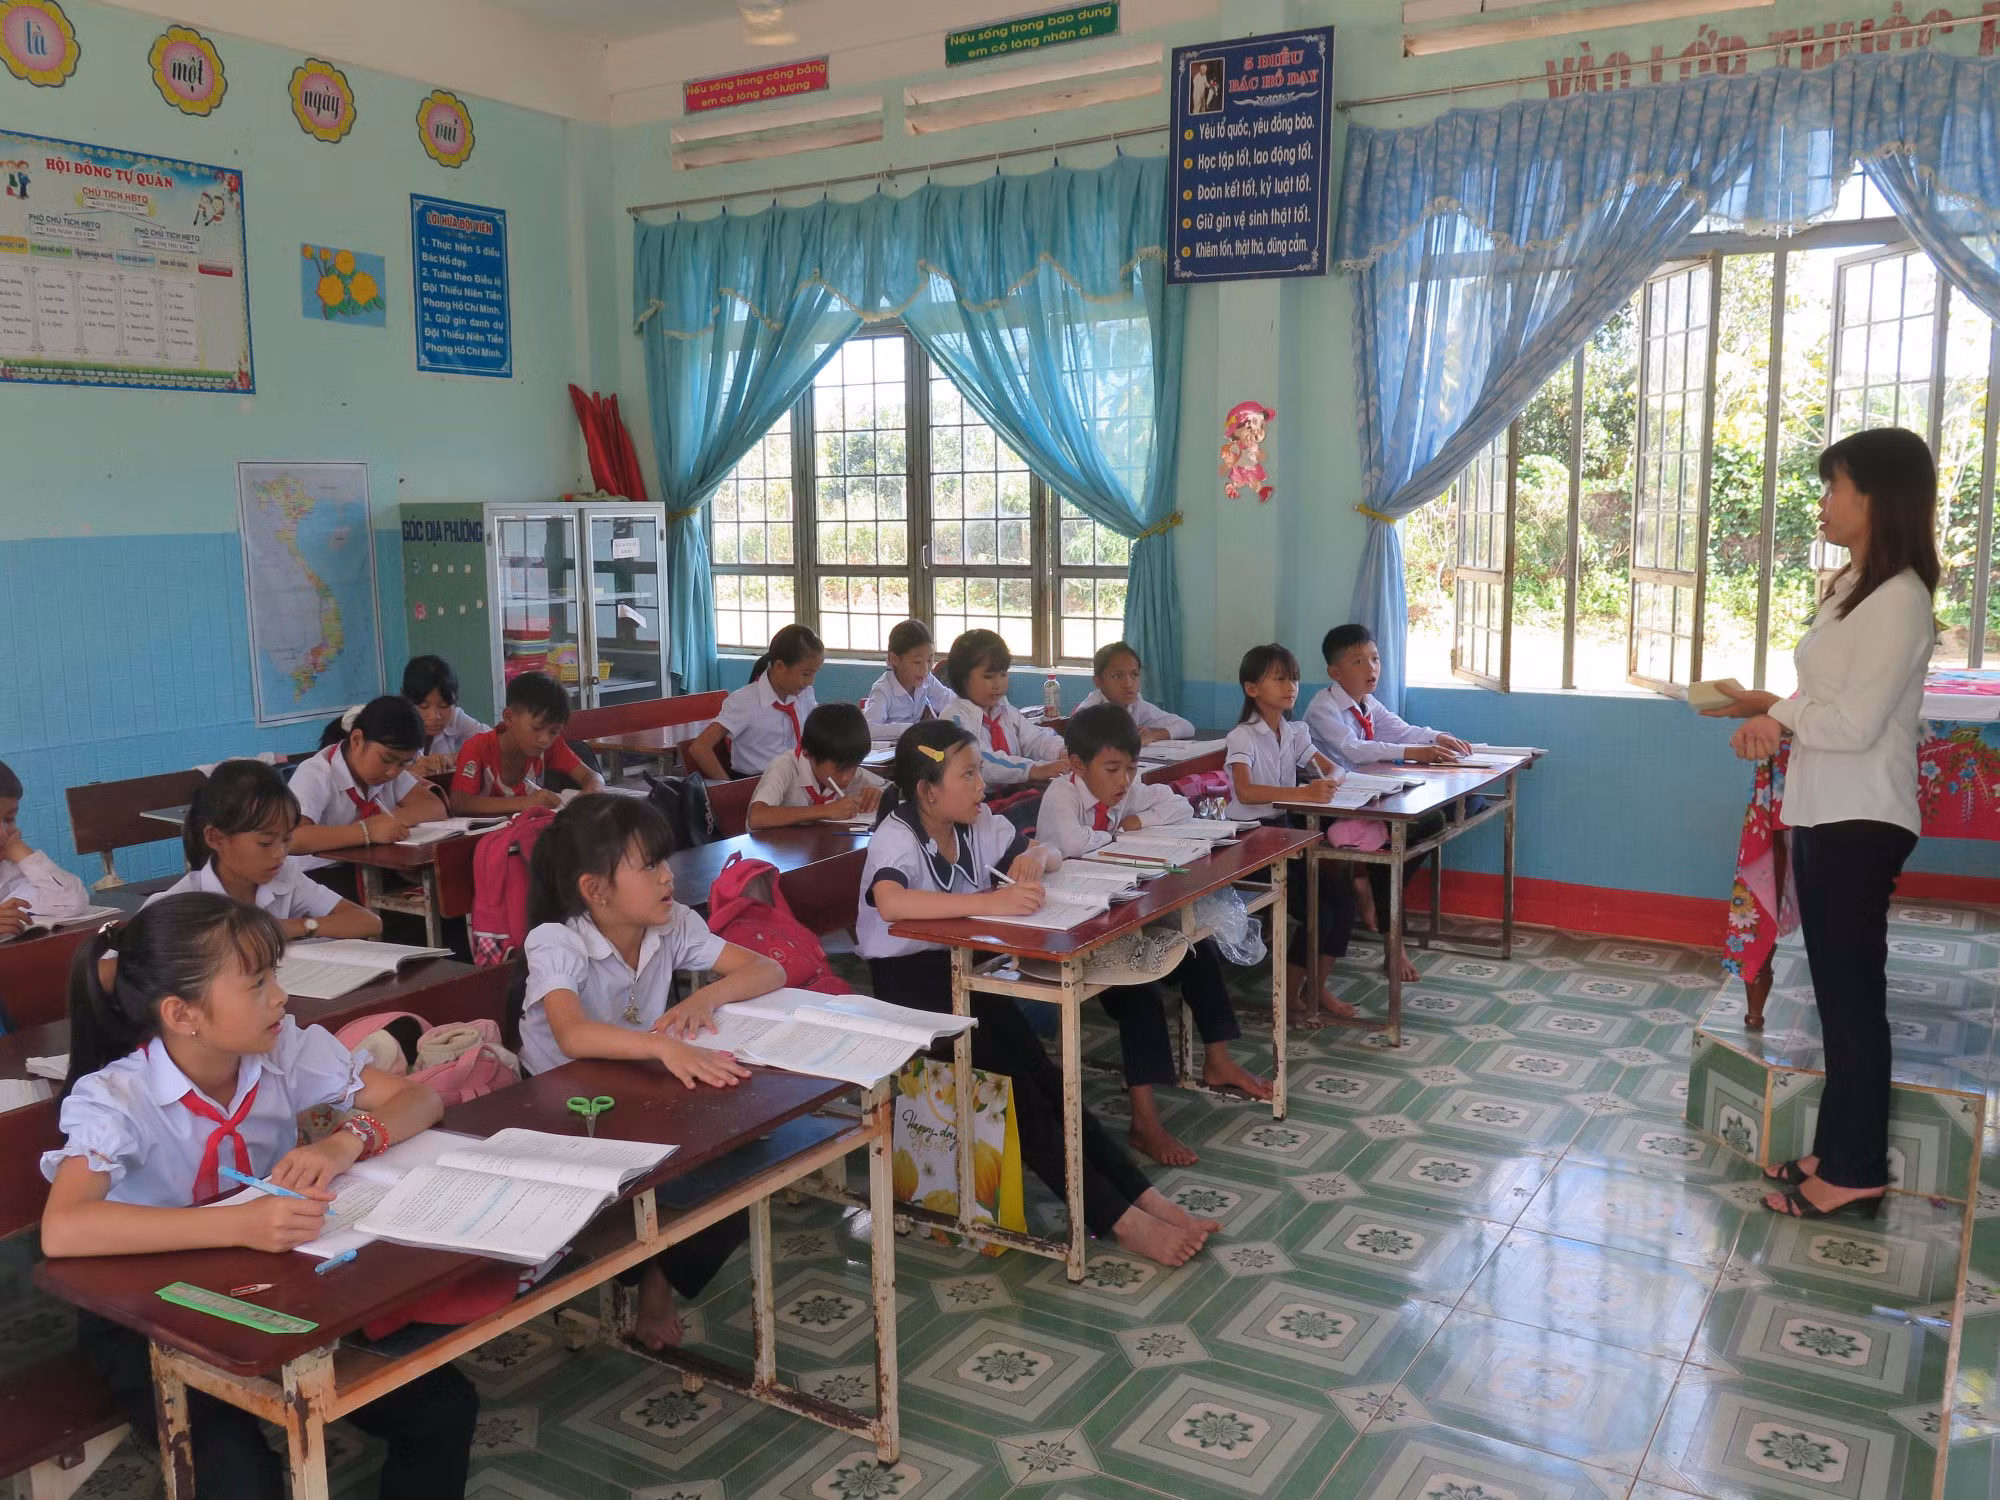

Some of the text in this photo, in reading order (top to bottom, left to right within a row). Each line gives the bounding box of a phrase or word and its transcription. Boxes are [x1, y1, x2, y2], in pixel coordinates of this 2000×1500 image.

[978, 27, 1008, 40] sống
[1012, 20, 1044, 33] trong
[1048, 14, 1074, 26] bao
[1078, 6, 1112, 20] dung
[968, 48, 987, 58] em
[992, 42, 1007, 53] có
[1012, 35, 1039, 48] lòng
[1043, 27, 1075, 43] nhân
[1244, 46, 1304, 70] 5 ĐIỀU
[25, 17, 458, 143] là một ngày vui
[737, 75, 763, 86] trong
[1229, 68, 1319, 92] BÁC HỒ DẠY
[702, 98, 717, 106] em
[720, 94, 733, 103] có
[737, 91, 759, 101] lòng
[1217, 116, 1226, 138] tổ
[1228, 117, 1251, 140] quốc,
[1253, 118, 1269, 138] yêu
[1198, 153, 1216, 173] Học
[1218, 151, 1234, 171] tập
[1237, 147, 1251, 167] tốt,
[1253, 148, 1268, 164] lao
[1271, 145, 1296, 166] động
[1298, 140, 1313, 160] tốt.
[46, 157, 173, 188] HỘI ĐỒNG TỰ QUẢN
[1198, 182, 1222, 200] Đoàn
[1225, 178, 1240, 198] kết
[1242, 177, 1258, 198] tốt,
[1260, 175, 1272, 198] kỷ
[1275, 176, 1293, 197] luật
[1296, 173, 1311, 192] tốt.
[1197, 213, 1214, 230] Giữ
[1234, 211, 1245, 229] vệ
[1249, 209, 1268, 226] sinh
[1271, 206, 1291, 227] thật
[1294, 204, 1311, 223] tốt.
[421, 237, 429, 246] 1.
[432, 238, 452, 251] Thực
[455, 242, 473, 254] hiện
[476, 246, 480, 254] 5
[1196, 240, 1218, 258] Khiêm
[1219, 238, 1233, 257] tốn,
[1235, 238, 1250, 258] thật
[1267, 238, 1286, 256] dũng
[1289, 232, 1308, 252] cảm.
[422, 252, 438, 262] Bác
[452, 257, 468, 268] dạy.
[422, 268, 429, 276] 2.
[454, 272, 472, 282] theo
[423, 282, 437, 293] Đội
[464, 288, 483, 298] Niên
[423, 298, 451, 311] Phong
[465, 303, 478, 312] Chí
[480, 304, 502, 315] Minh.
[424, 313, 432, 321] 3.
[470, 318, 489, 327] danh
[425, 327, 439, 338] Đội
[466, 332, 484, 342] Niên
[425, 342, 453, 355] Phong
[466, 346, 480, 356] Chí
[482, 348, 503, 358] Minh.
[402, 514, 423, 541] GÓC
[426, 521, 442, 546] ĐỊA
[902, 1110, 938, 1142] Happy
